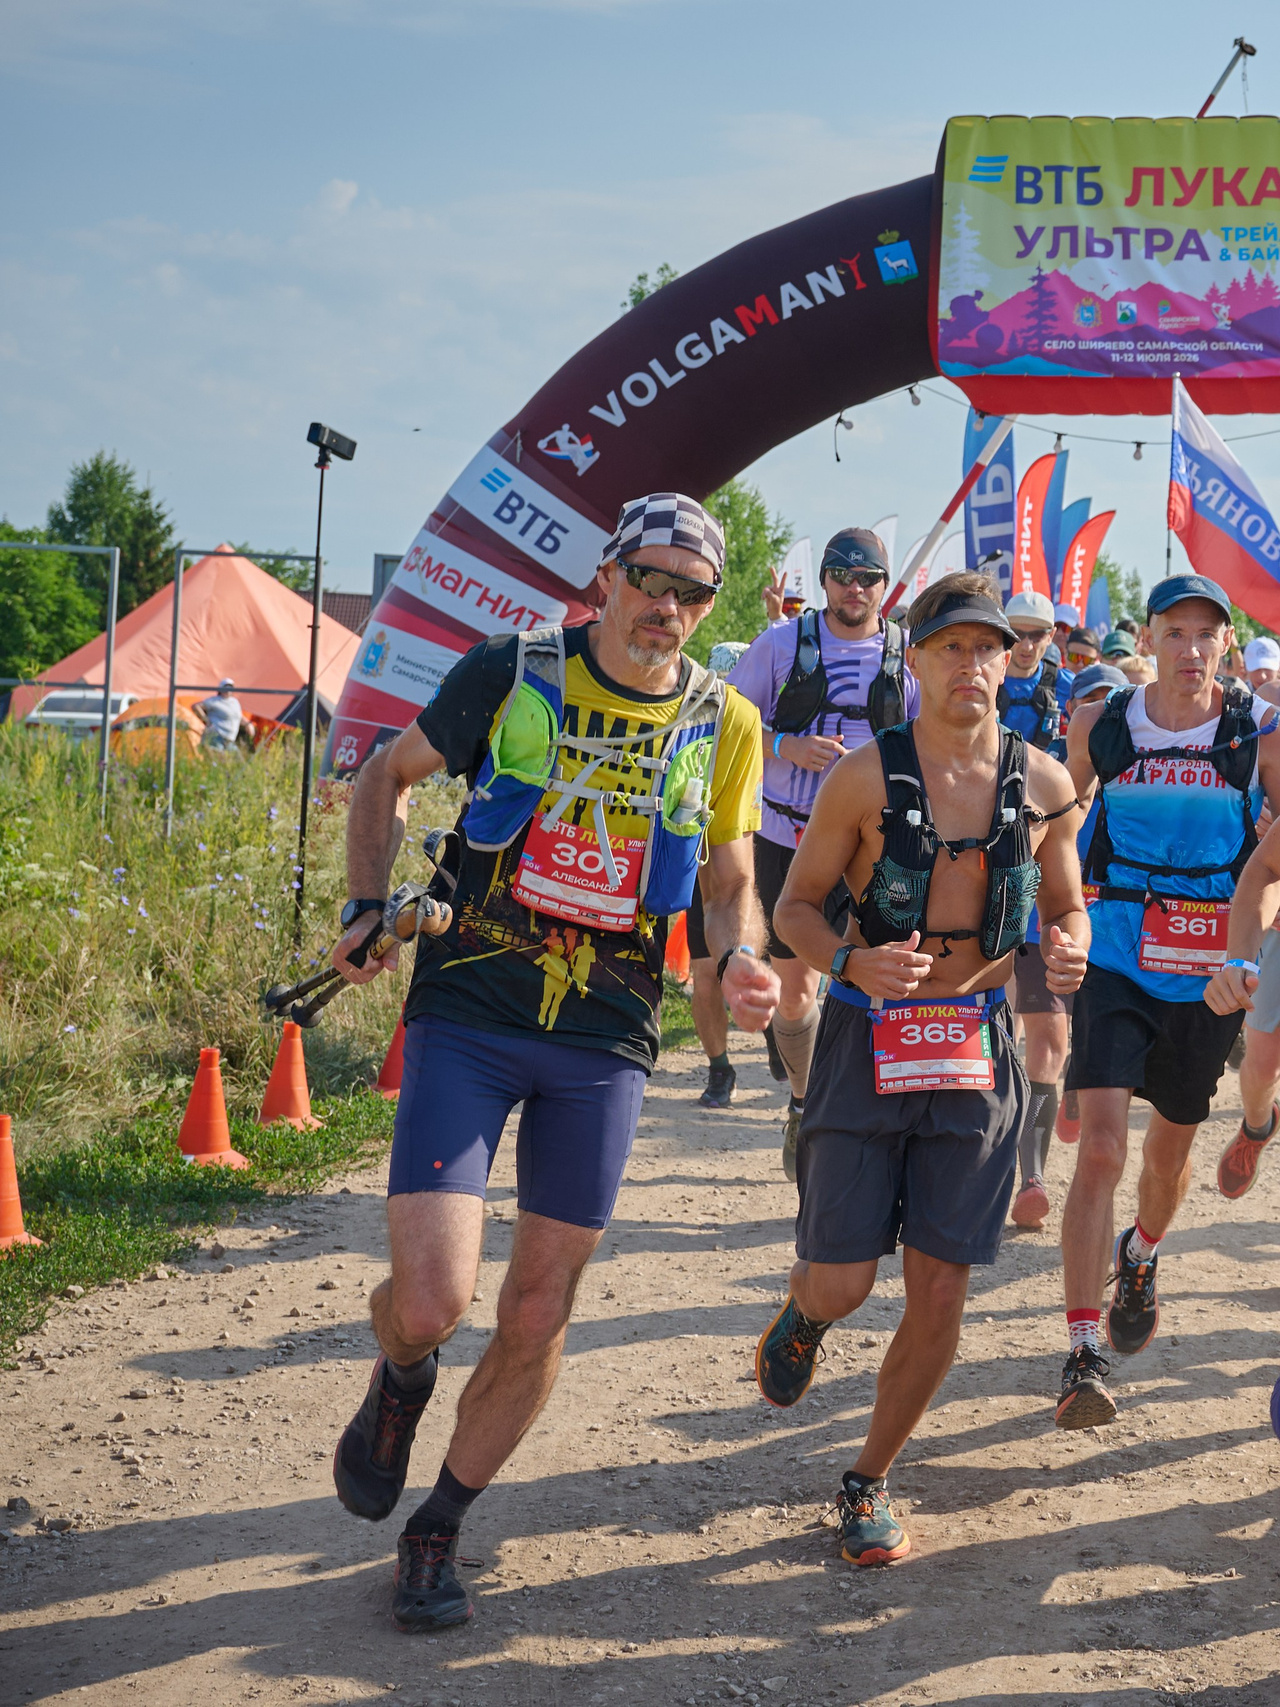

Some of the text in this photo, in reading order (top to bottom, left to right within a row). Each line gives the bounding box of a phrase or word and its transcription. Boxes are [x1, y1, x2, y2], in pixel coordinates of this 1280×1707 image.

[1014, 164, 1104, 206] ВТБ
[1013, 224, 1211, 262] УЛЬТРА
[1219, 247, 1232, 262] &
[1044, 339, 1264, 352] СЕЛО ШИРЯЕВО САМАРСКОЙ ОБЛАСТИ
[1111, 353, 1135, 363] 11-12
[1136, 353, 1171, 363] ИЮЛЯ
[493, 489, 570, 555] ВТБ
[391, 664, 439, 689] Самарско
[396, 654, 446, 679] Министер
[336, 747, 358, 766] GO
[627, 839, 647, 848] УЛЬТ
[551, 842, 631, 881] 306
[551, 870, 619, 894] АЛЕКСАНДР
[1082, 886, 1096, 894] КА
[1181, 902, 1216, 914] ЛУКА
[1168, 916, 1218, 936] 361
[889, 1008, 912, 1021] ВТБ
[916, 1006, 958, 1018] ЛУКА
[900, 1023, 967, 1045] 365
[982, 1024, 990, 1057] ТРЕЙЛ
